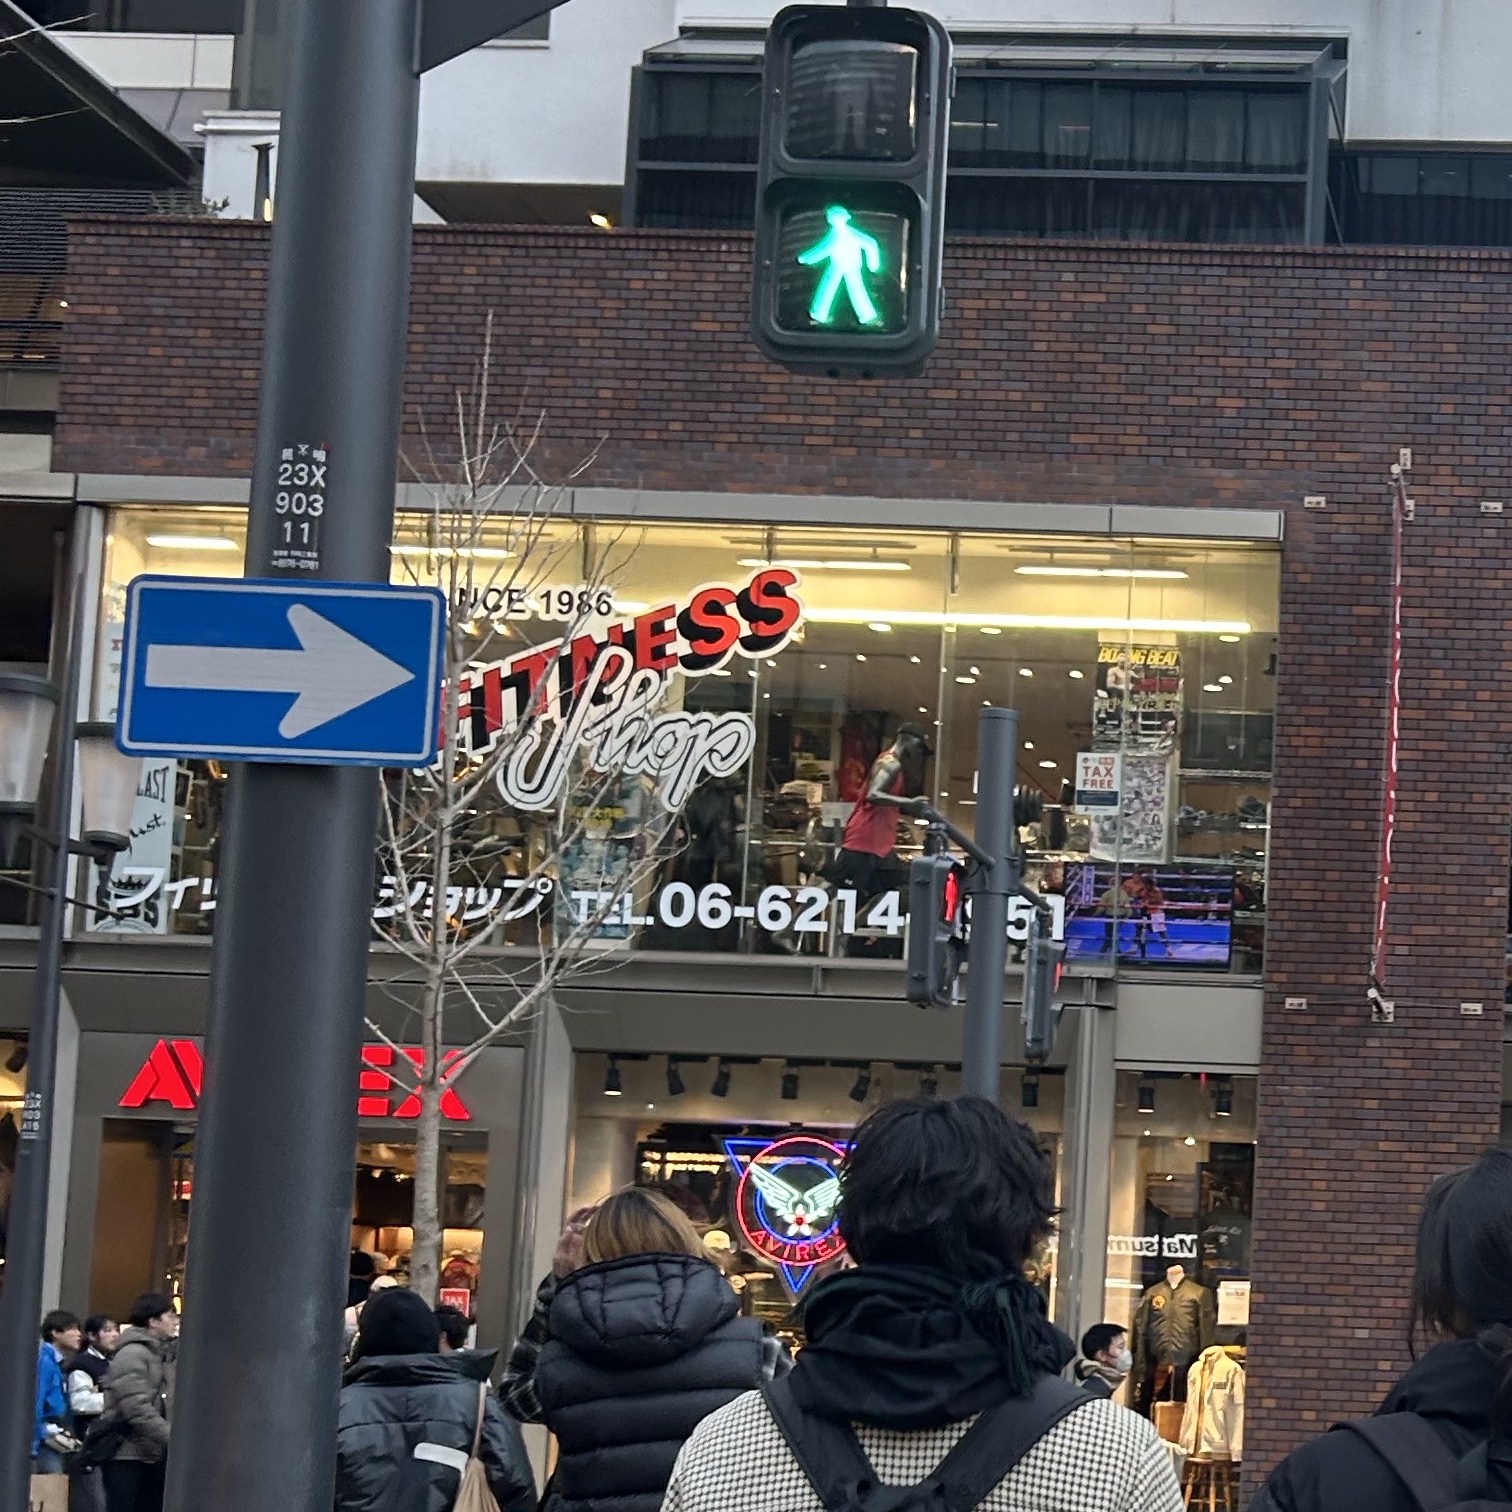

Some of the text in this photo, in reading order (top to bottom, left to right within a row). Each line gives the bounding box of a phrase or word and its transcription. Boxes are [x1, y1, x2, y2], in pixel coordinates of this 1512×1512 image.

[278, 463, 327, 487] 23X
[275, 492, 324, 516] 903
[283, 521, 310, 544] 11
[540, 590, 613, 616] 1986
[496, 645, 757, 812] Shop
[1082, 766, 1114, 778] TAX
[1082, 778, 1114, 789] FREE
